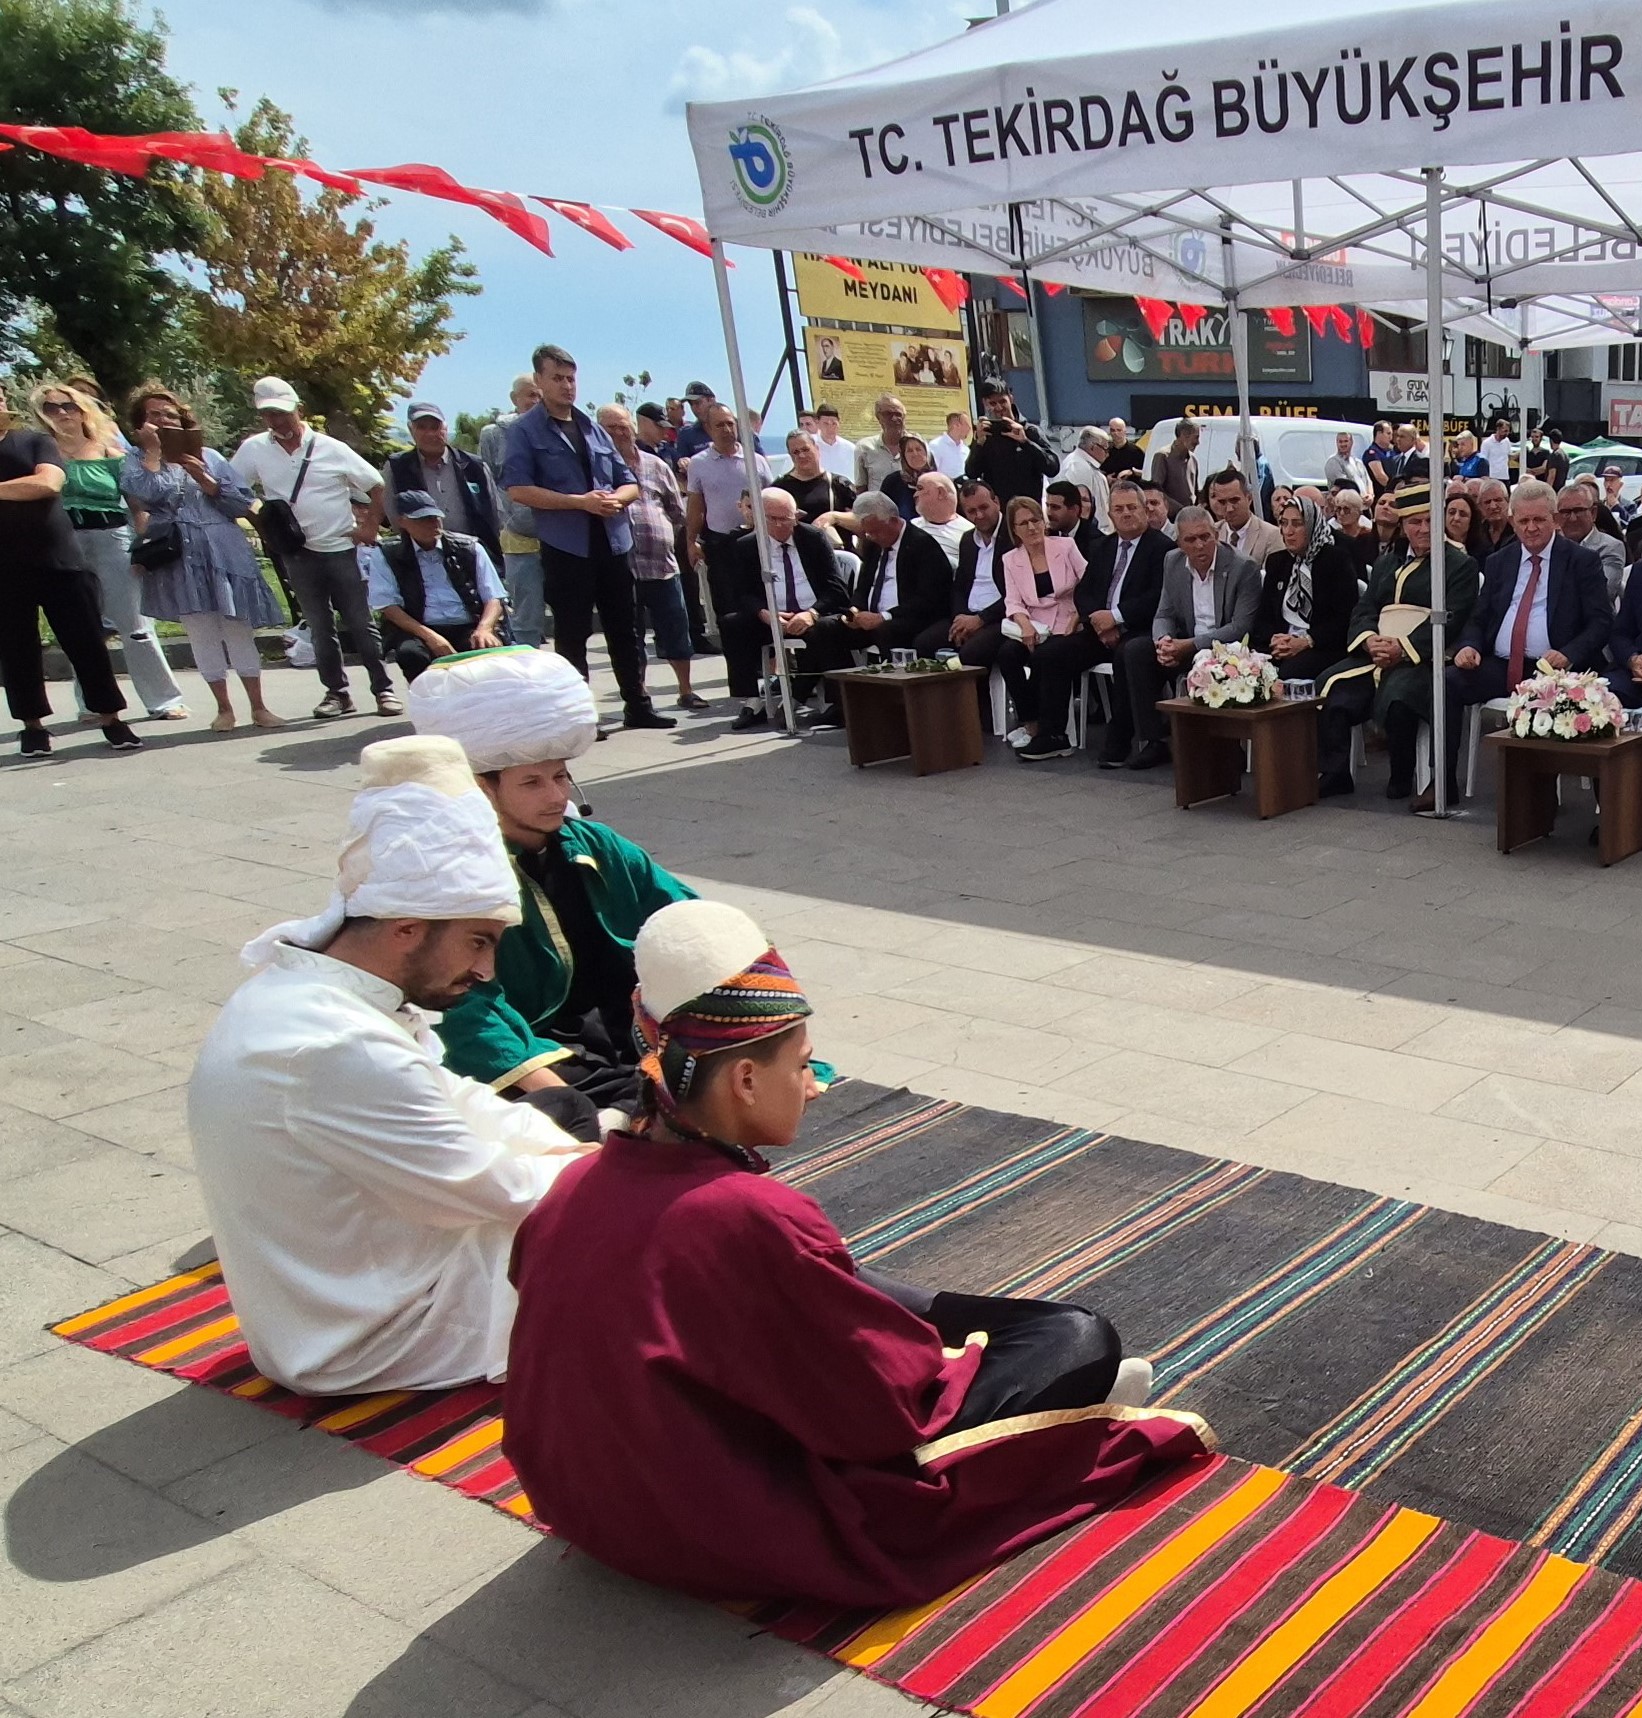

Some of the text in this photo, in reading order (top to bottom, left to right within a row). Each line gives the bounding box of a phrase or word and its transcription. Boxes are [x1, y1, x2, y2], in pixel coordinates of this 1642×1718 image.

[849, 122, 924, 179] TC.
[934, 69, 1195, 166] TEKİRDAĞ
[1213, 20, 1625, 138] BÜYÜKŞEHİR
[843, 279, 918, 305] MEYDANI
